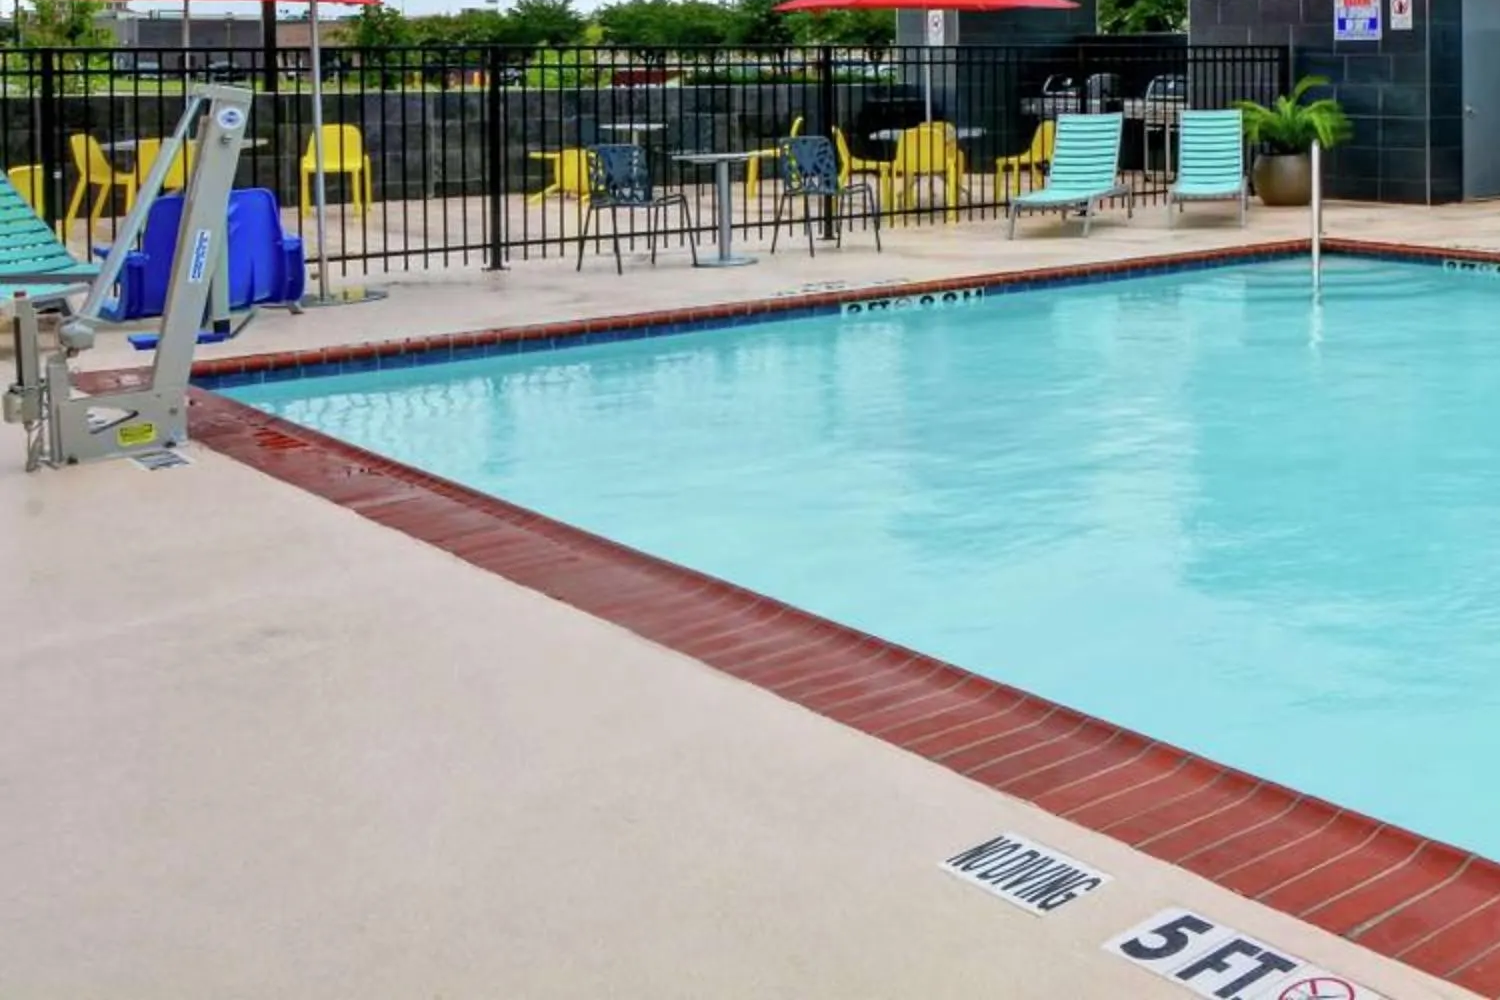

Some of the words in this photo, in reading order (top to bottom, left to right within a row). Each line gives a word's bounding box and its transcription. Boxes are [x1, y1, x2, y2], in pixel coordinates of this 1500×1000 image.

[946, 835, 1023, 872] NO
[975, 849, 1102, 911] DIVING
[1119, 914, 1214, 961] 5
